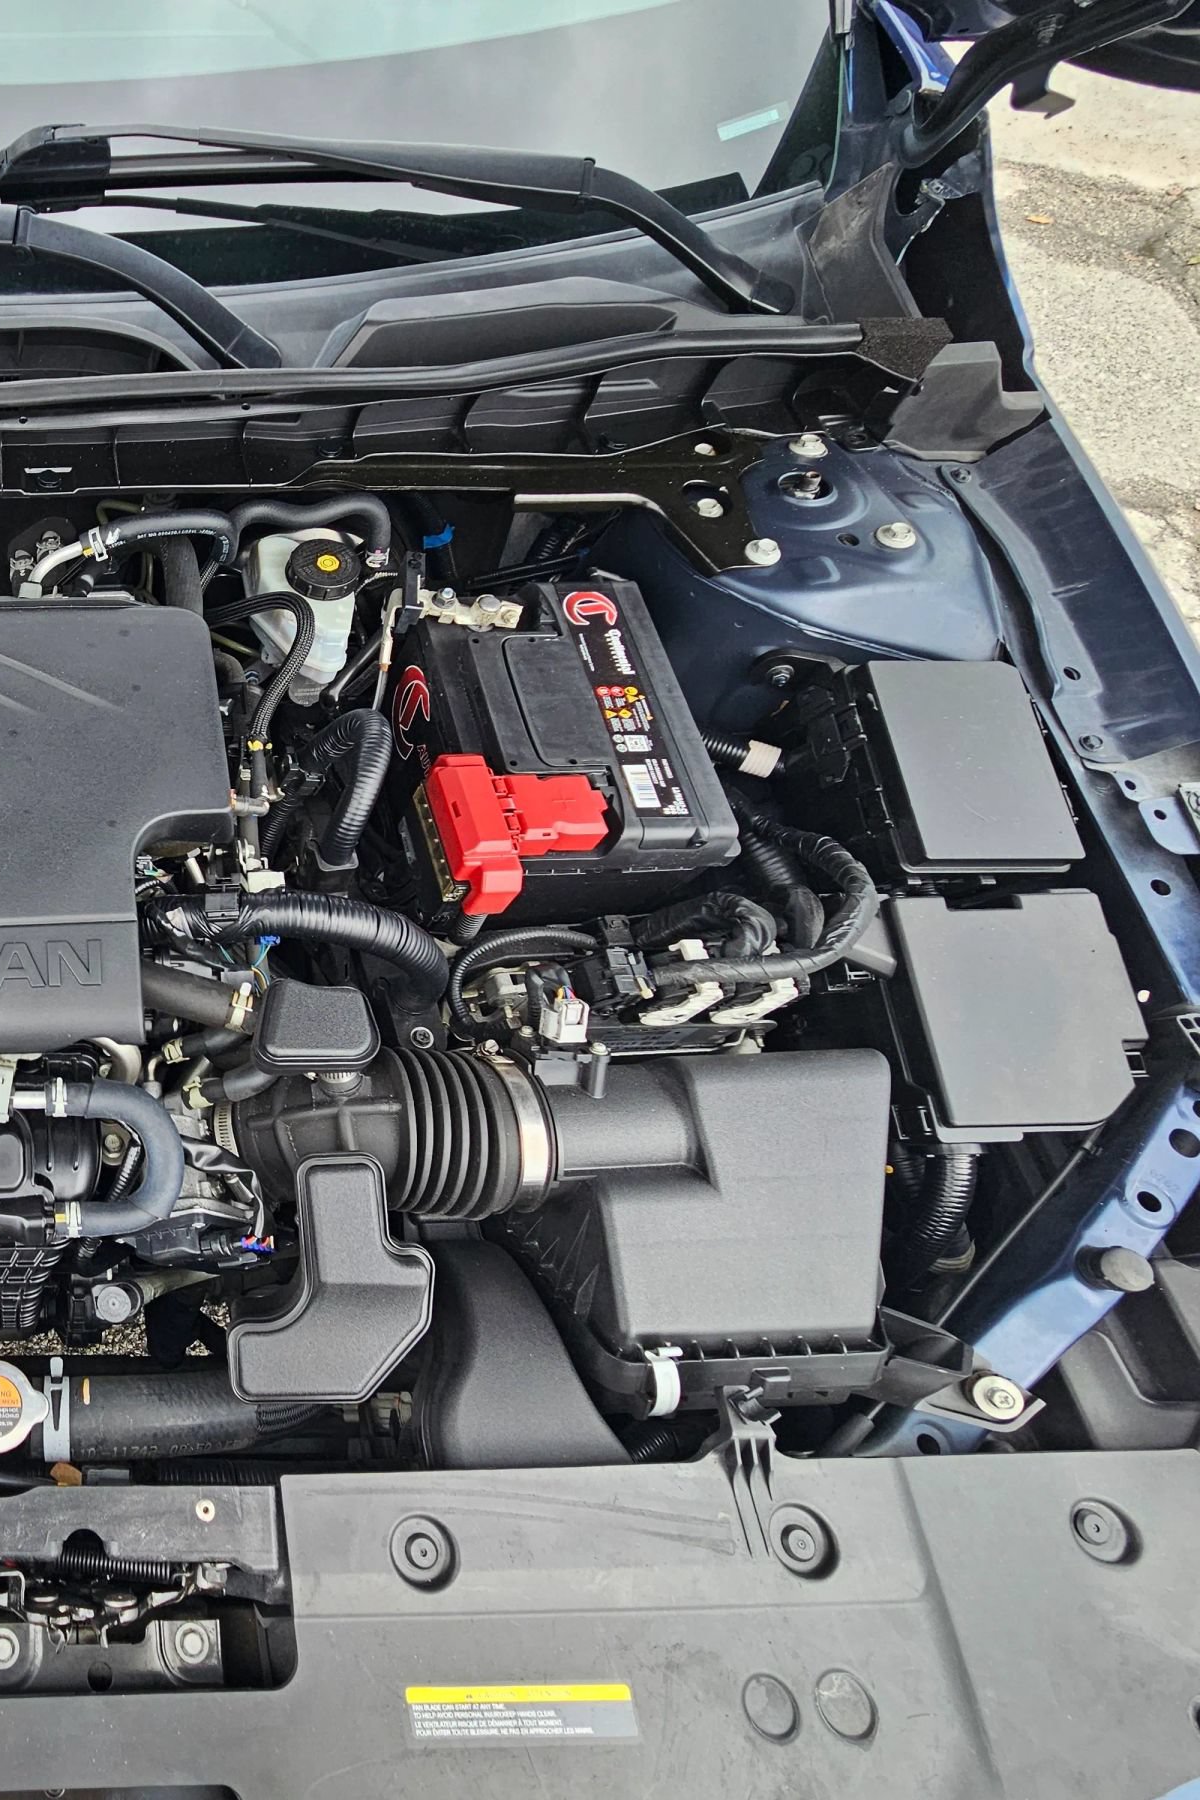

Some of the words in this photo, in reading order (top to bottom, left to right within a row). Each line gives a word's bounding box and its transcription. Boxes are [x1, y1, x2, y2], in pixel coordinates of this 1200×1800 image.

[414, 1711, 421, 1719] TO
[422, 1711, 436, 1719] HELP
[437, 1711, 454, 1719] AVOID
[454, 1711, 483, 1719] PERSONAL
[517, 1710, 536, 1718] HANDS
[414, 1720, 422, 1728] LE
[422, 1720, 457, 1728] VENTILATEUR
[457, 1720, 478, 1728] RISQUE
[487, 1718, 518, 1727] DÉMARRER
[416, 1728, 432, 1736] POUR
[451, 1728, 469, 1736] TOUTE
[529, 1727, 563, 1735] APPROCHER
[563, 1727, 574, 1735] LES
